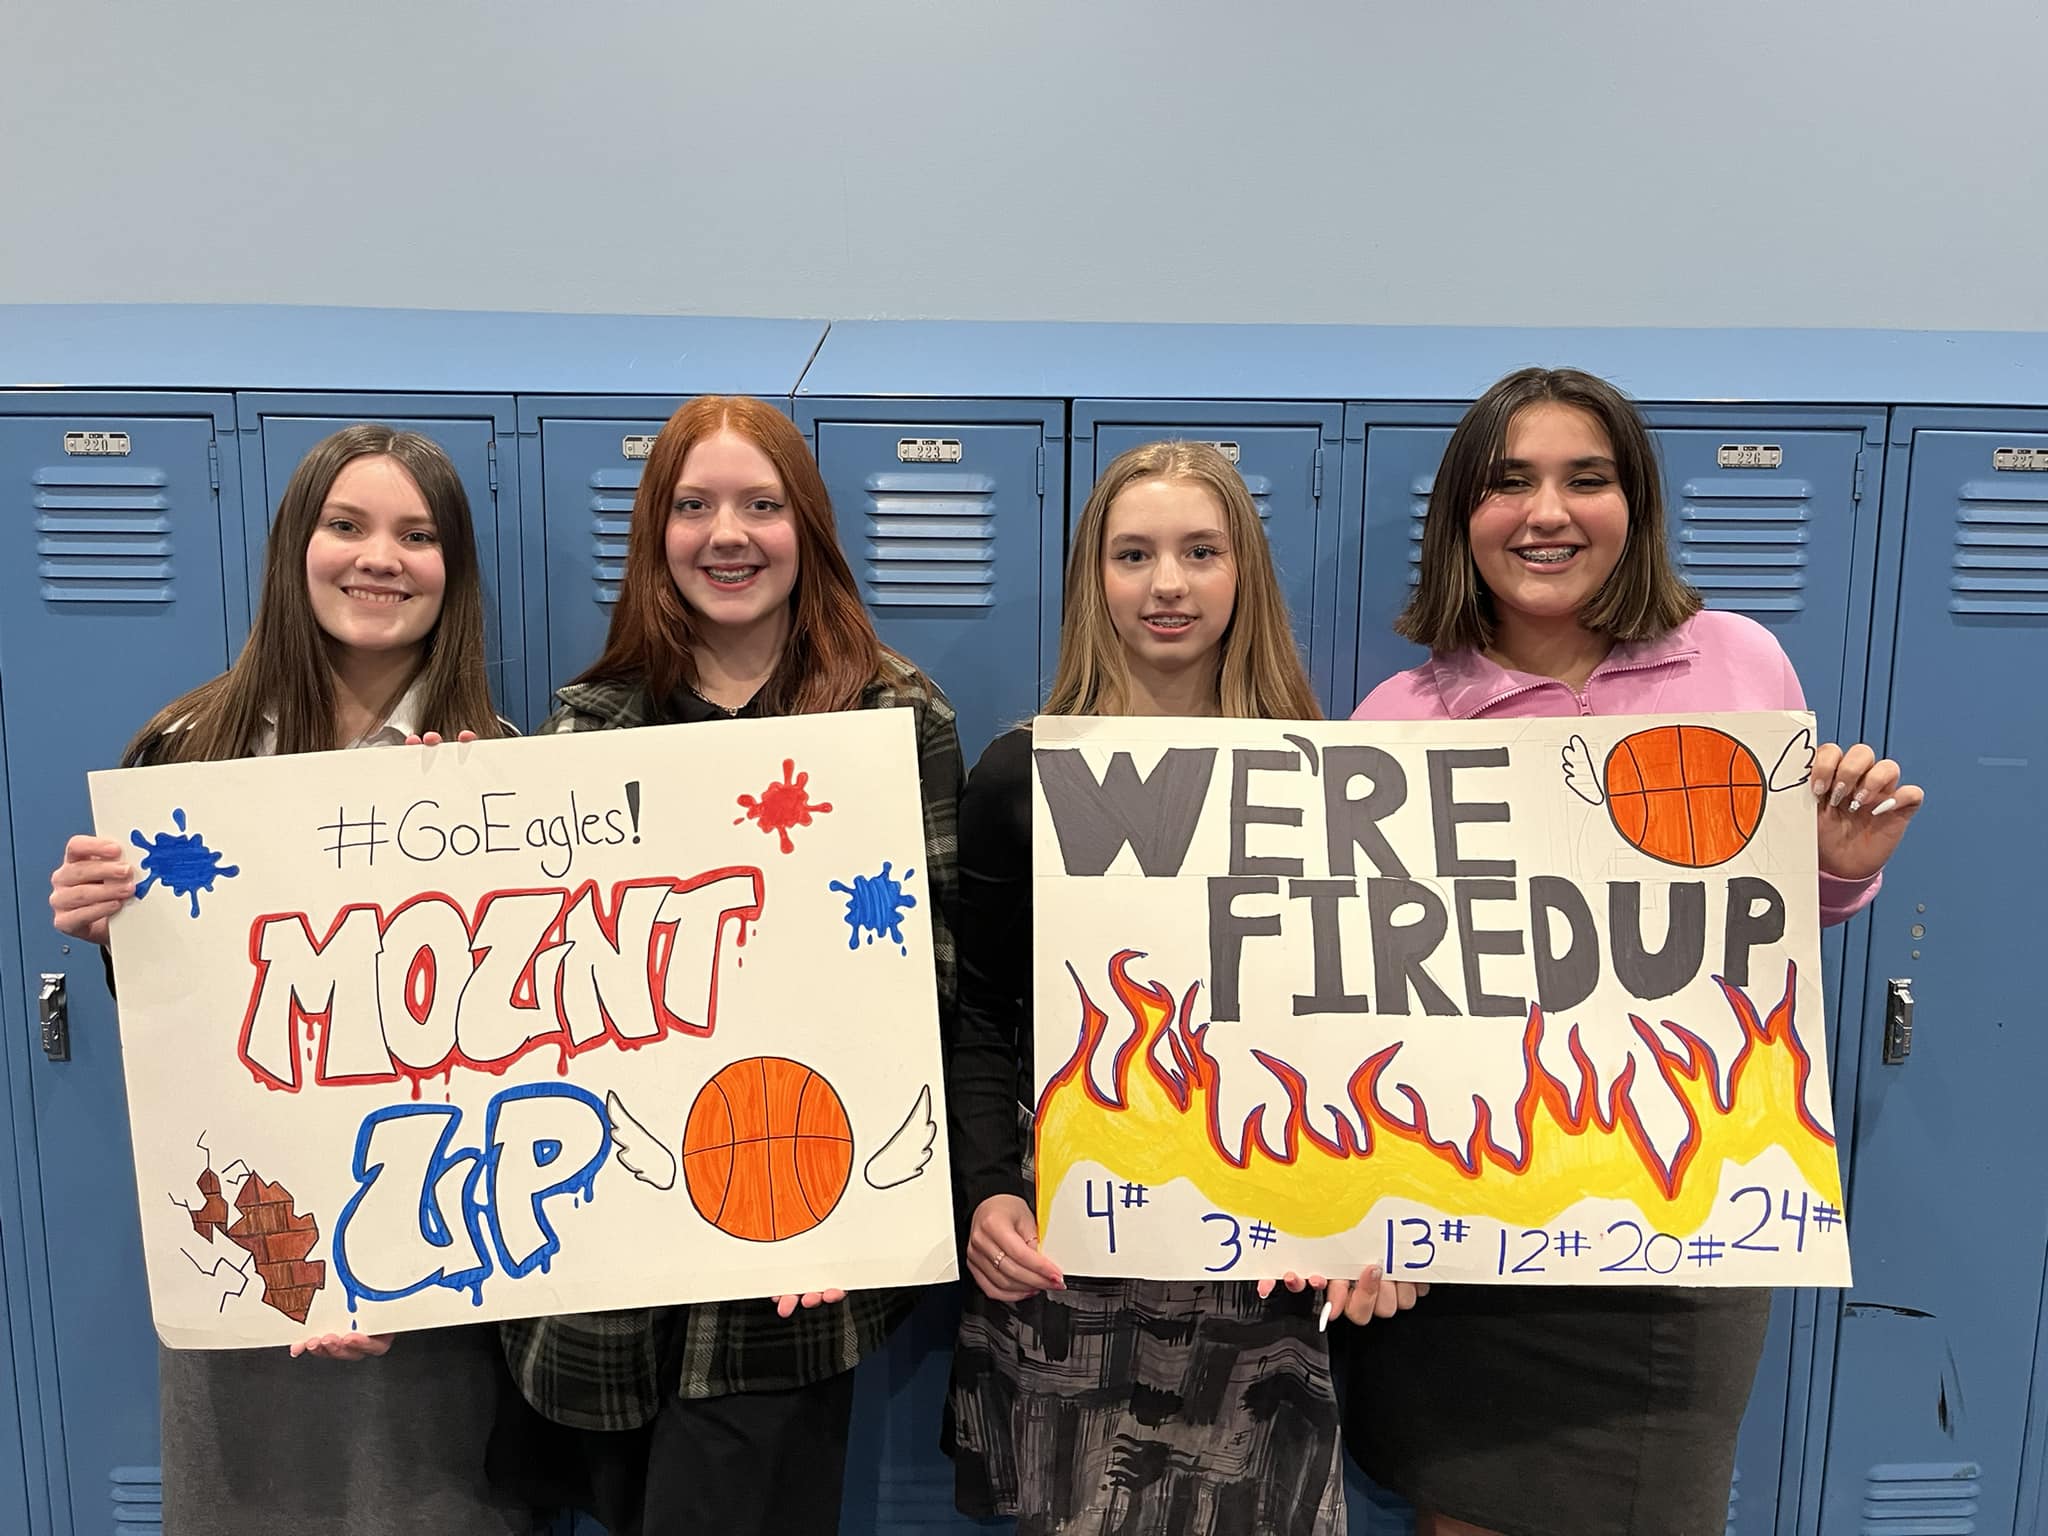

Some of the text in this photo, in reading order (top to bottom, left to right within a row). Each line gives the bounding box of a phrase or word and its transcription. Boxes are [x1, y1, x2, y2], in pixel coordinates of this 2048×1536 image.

[83, 439, 109, 451] 220
[916, 445, 941, 458] 223
[1737, 451, 1761, 464] 226
[2012, 455, 2034, 468] 227
[1033, 733, 1517, 878] WE'RE
[317, 780, 643, 878] #GoEagles!
[332, 1083, 612, 1306] UP
